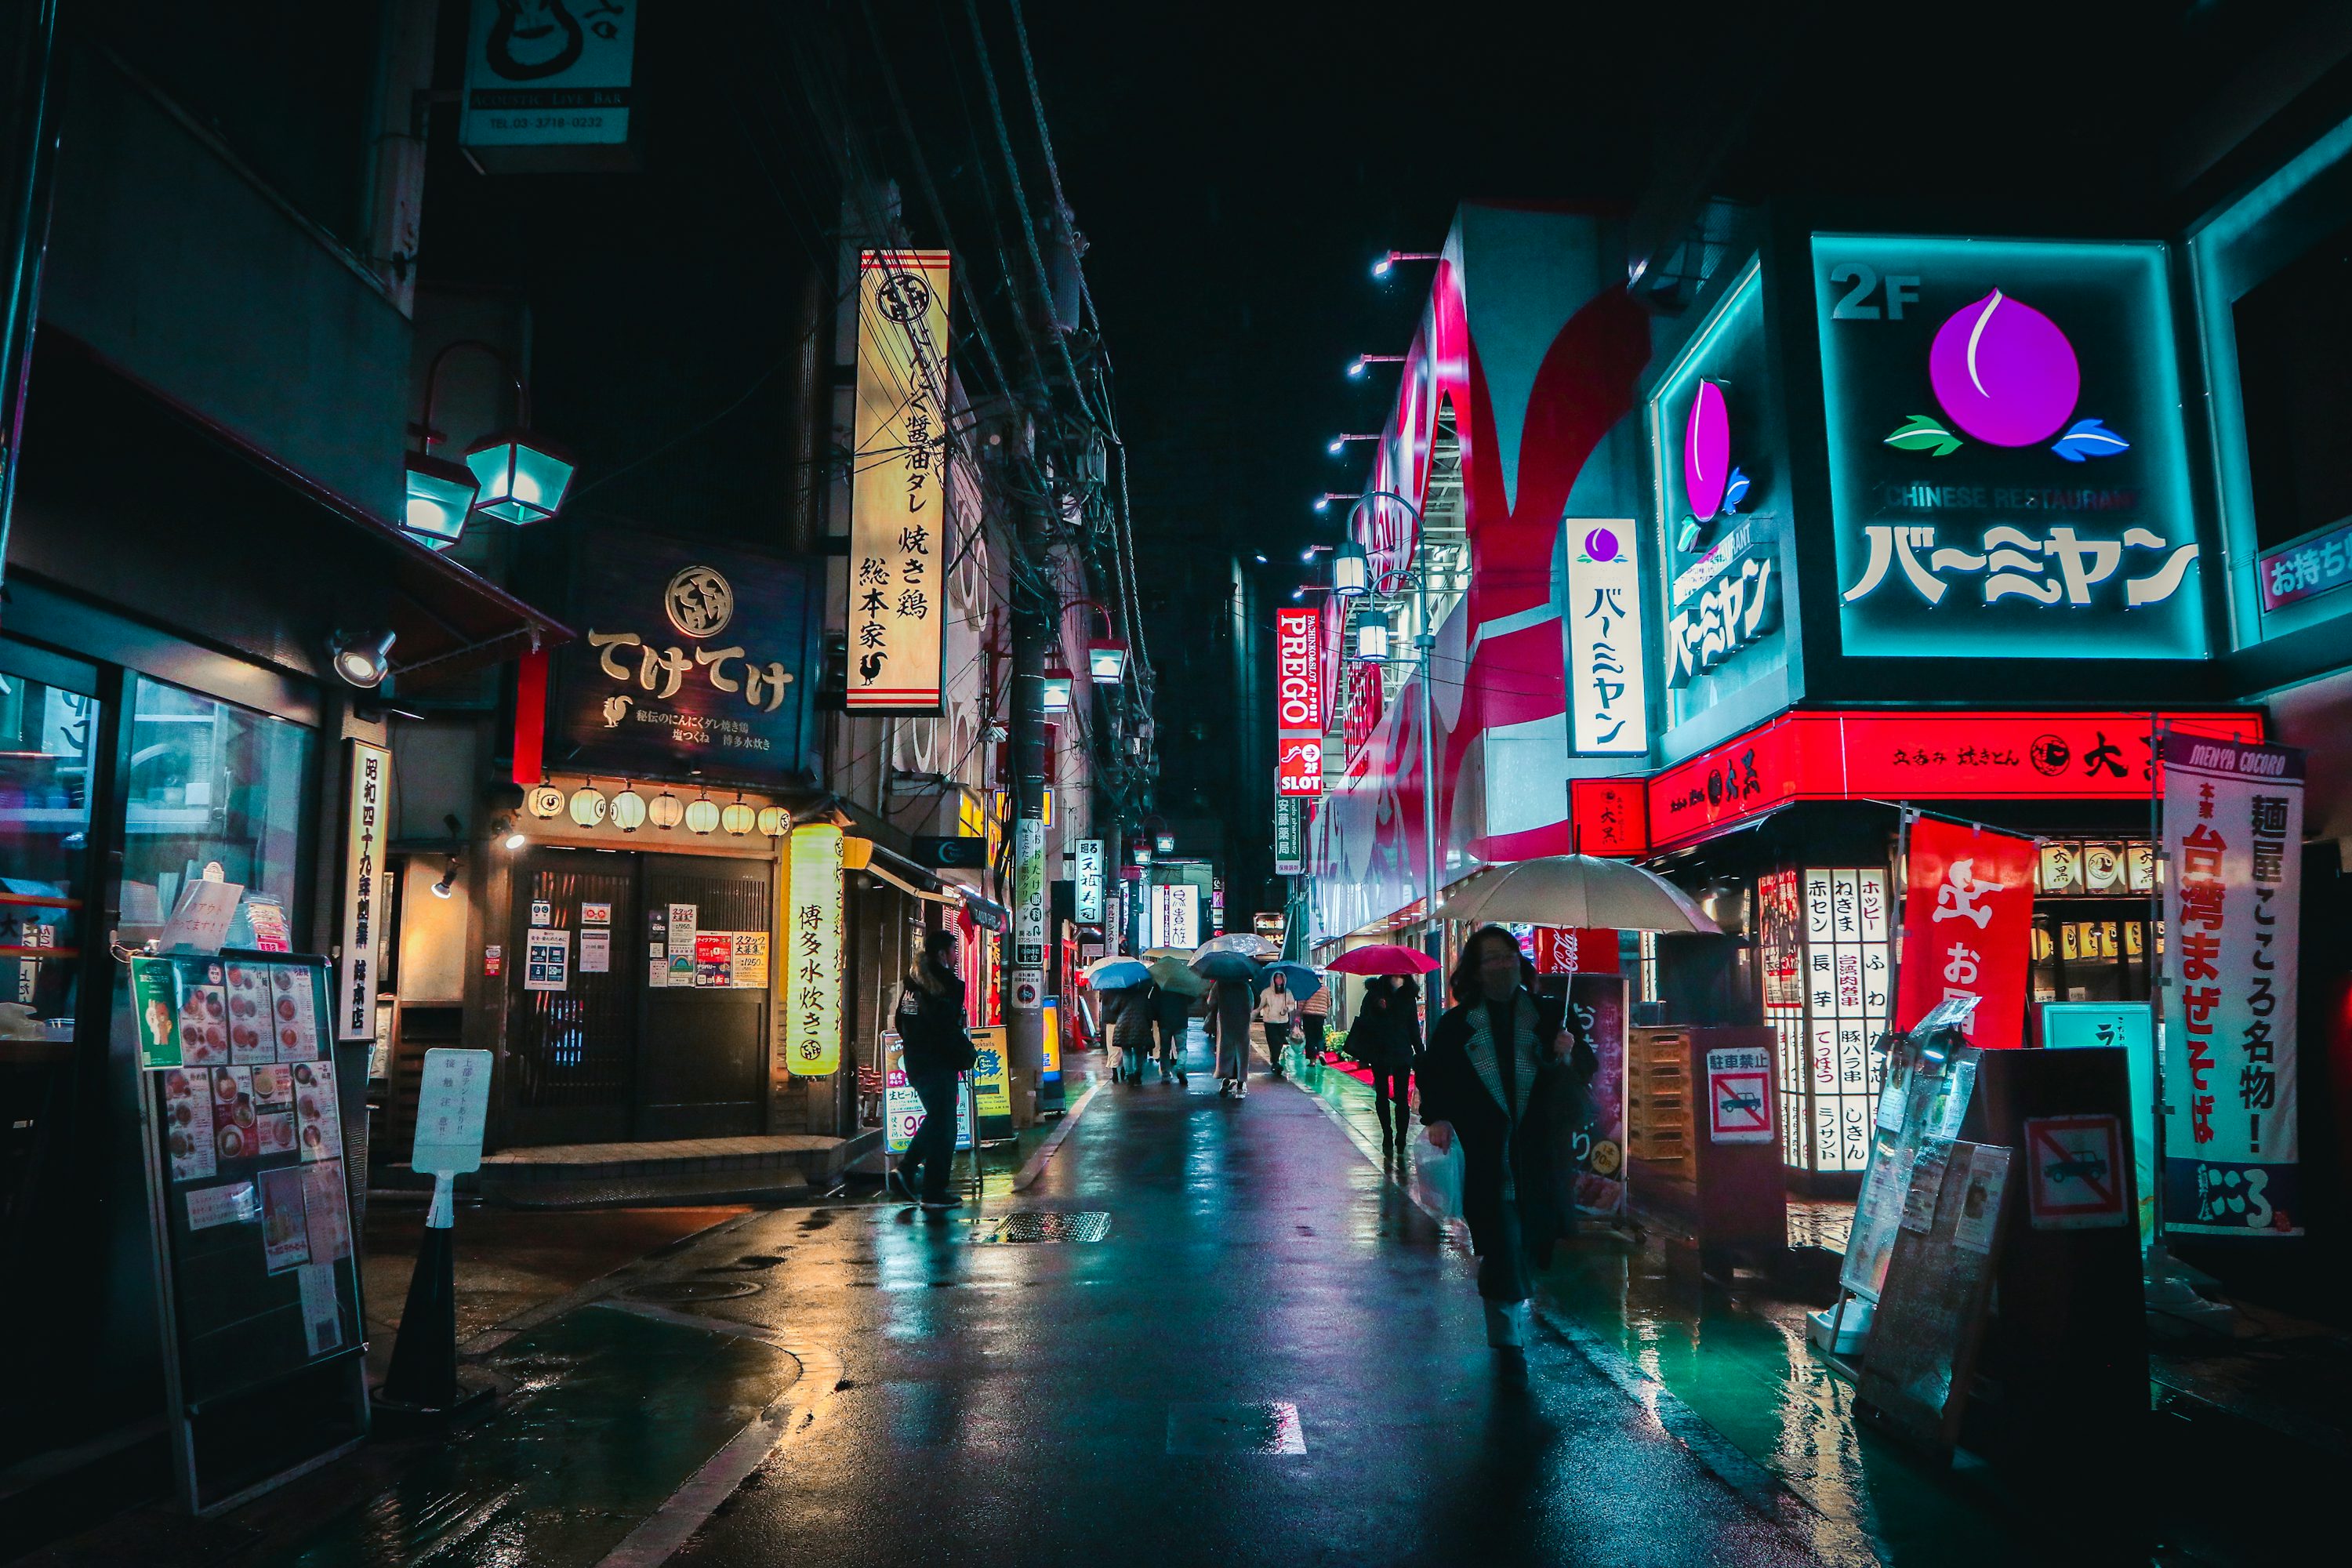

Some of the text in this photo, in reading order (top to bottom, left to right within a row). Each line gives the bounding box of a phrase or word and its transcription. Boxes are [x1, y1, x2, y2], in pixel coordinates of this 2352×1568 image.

[593, 91, 622, 104] BAR
[1830, 263, 1921, 320] 2F
[1886, 485, 1987, 509] CHINESE
[896, 524, 930, 621] 焼き鶏
[1843, 525, 2199, 607] バーミヤン
[858, 557, 891, 649] 総本家
[1667, 557, 1771, 690] バーミヤン
[588, 627, 794, 713] てけてけ
[1281, 614, 1308, 724] PREGO
[1584, 588, 1627, 746] バーミヤン
[1308, 687, 1318, 724] P-PORT
[1281, 776, 1321, 791] SLOT
[1304, 762, 1318, 774] 2F
[2189, 744, 2286, 776] MENYA COCORO
[2053, 849, 2070, 883] 大黒
[1172, 889, 1186, 945] 鳥貴族
[1835, 880, 1856, 932] ねぎま
[1861, 881, 1882, 931] ホッピー
[736, 935, 765, 945] スタッフ
[744, 958, 761, 967] 1250
[798, 904, 824, 1035] 博多水炊き
[1812, 954, 1832, 1007] 長芋
[1838, 955, 1860, 1007] 台湾肉巻串
[1866, 955, 1886, 1007] ふわ
[2181, 823, 2227, 1145] 台湾まぜそば
[2239, 794, 2289, 1154] 麺屋こころ名物!
[1710, 1053, 1769, 1069] 駐車禁止
[1813, 1032, 1835, 1083] てっぽう
[1842, 1030, 1862, 1083] 豚バラ串
[889, 1090, 918, 1101] 生ビール
[1846, 1107, 1865, 1160] しきん
